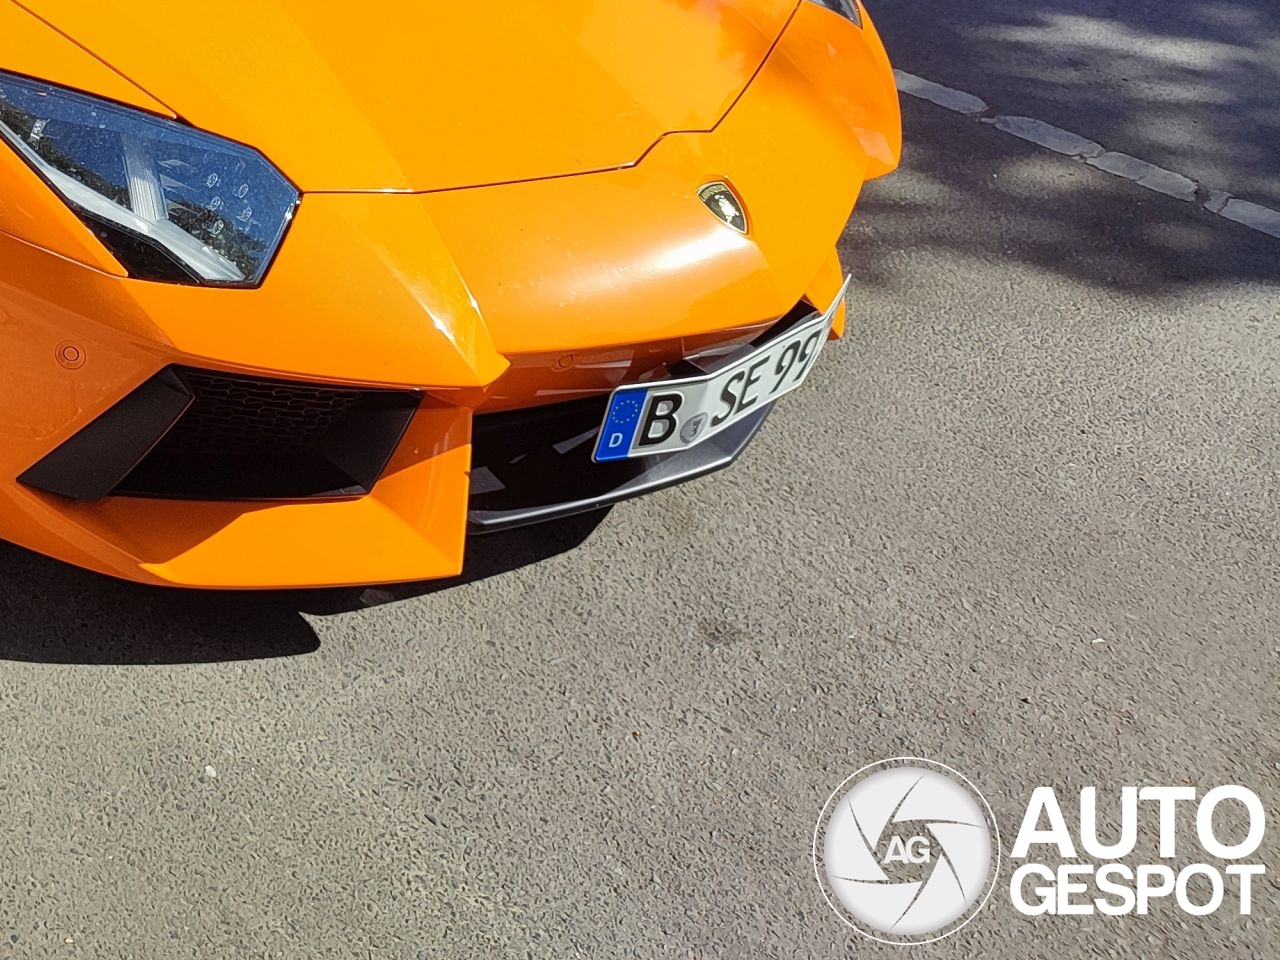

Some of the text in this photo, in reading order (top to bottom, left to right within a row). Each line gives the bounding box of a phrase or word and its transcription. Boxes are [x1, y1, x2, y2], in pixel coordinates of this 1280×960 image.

[638, 393, 683, 446] B
[710, 354, 771, 428] SE
[608, 432, 623, 448] D
